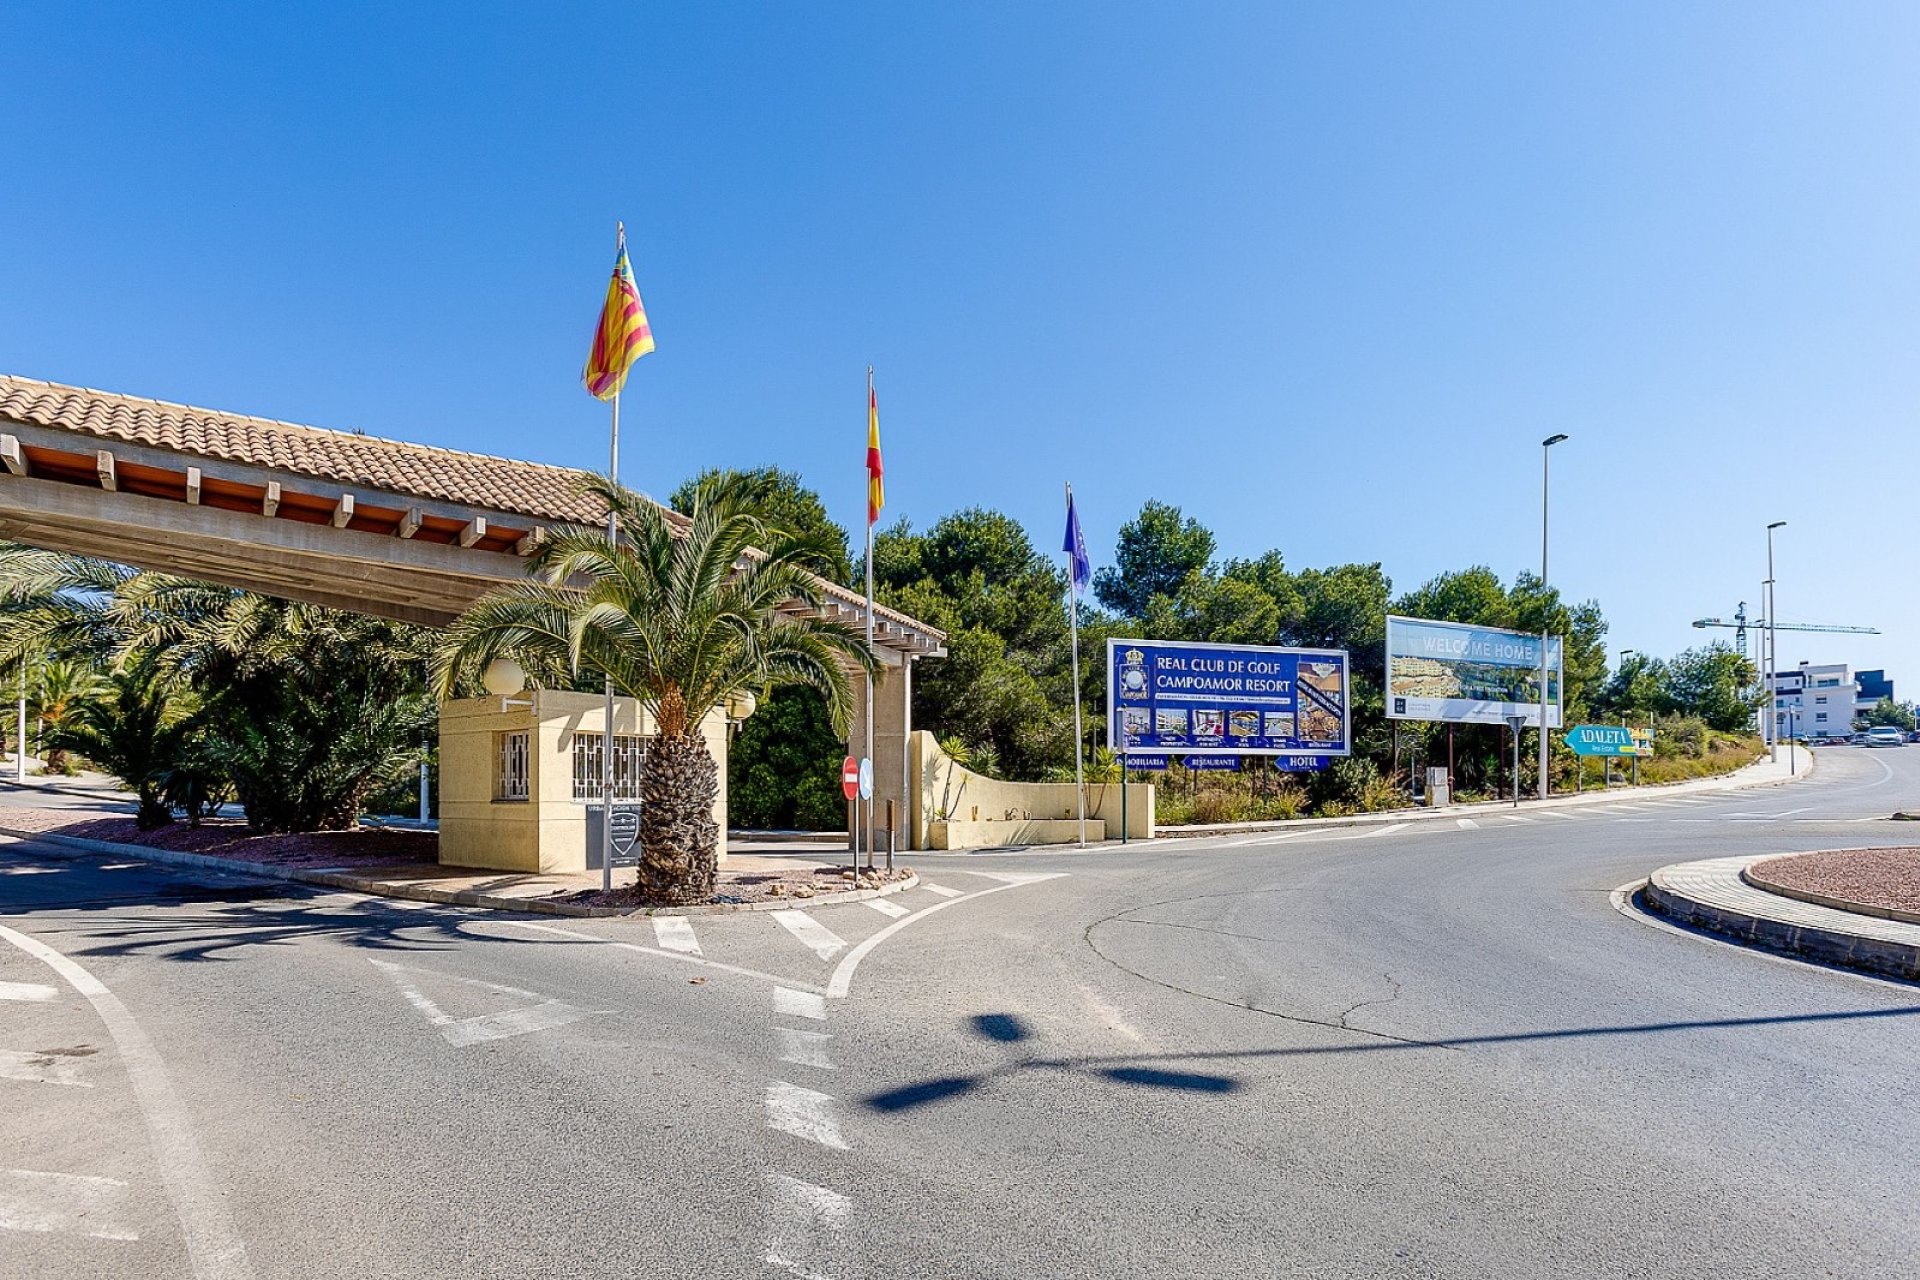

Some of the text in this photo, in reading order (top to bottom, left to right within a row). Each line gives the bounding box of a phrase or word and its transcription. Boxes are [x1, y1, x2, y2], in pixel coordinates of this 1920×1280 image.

[1423, 636, 1533, 660] WELCOME HOME
[1157, 657, 1281, 674] REAL CLUB DE GOLF
[1156, 675, 1291, 692] CAMPOAMOR RESORT
[1578, 729, 1627, 744] ADALETA
[1192, 758, 1235, 766] RESTAURANTE
[1290, 756, 1319, 767] HOTEL
